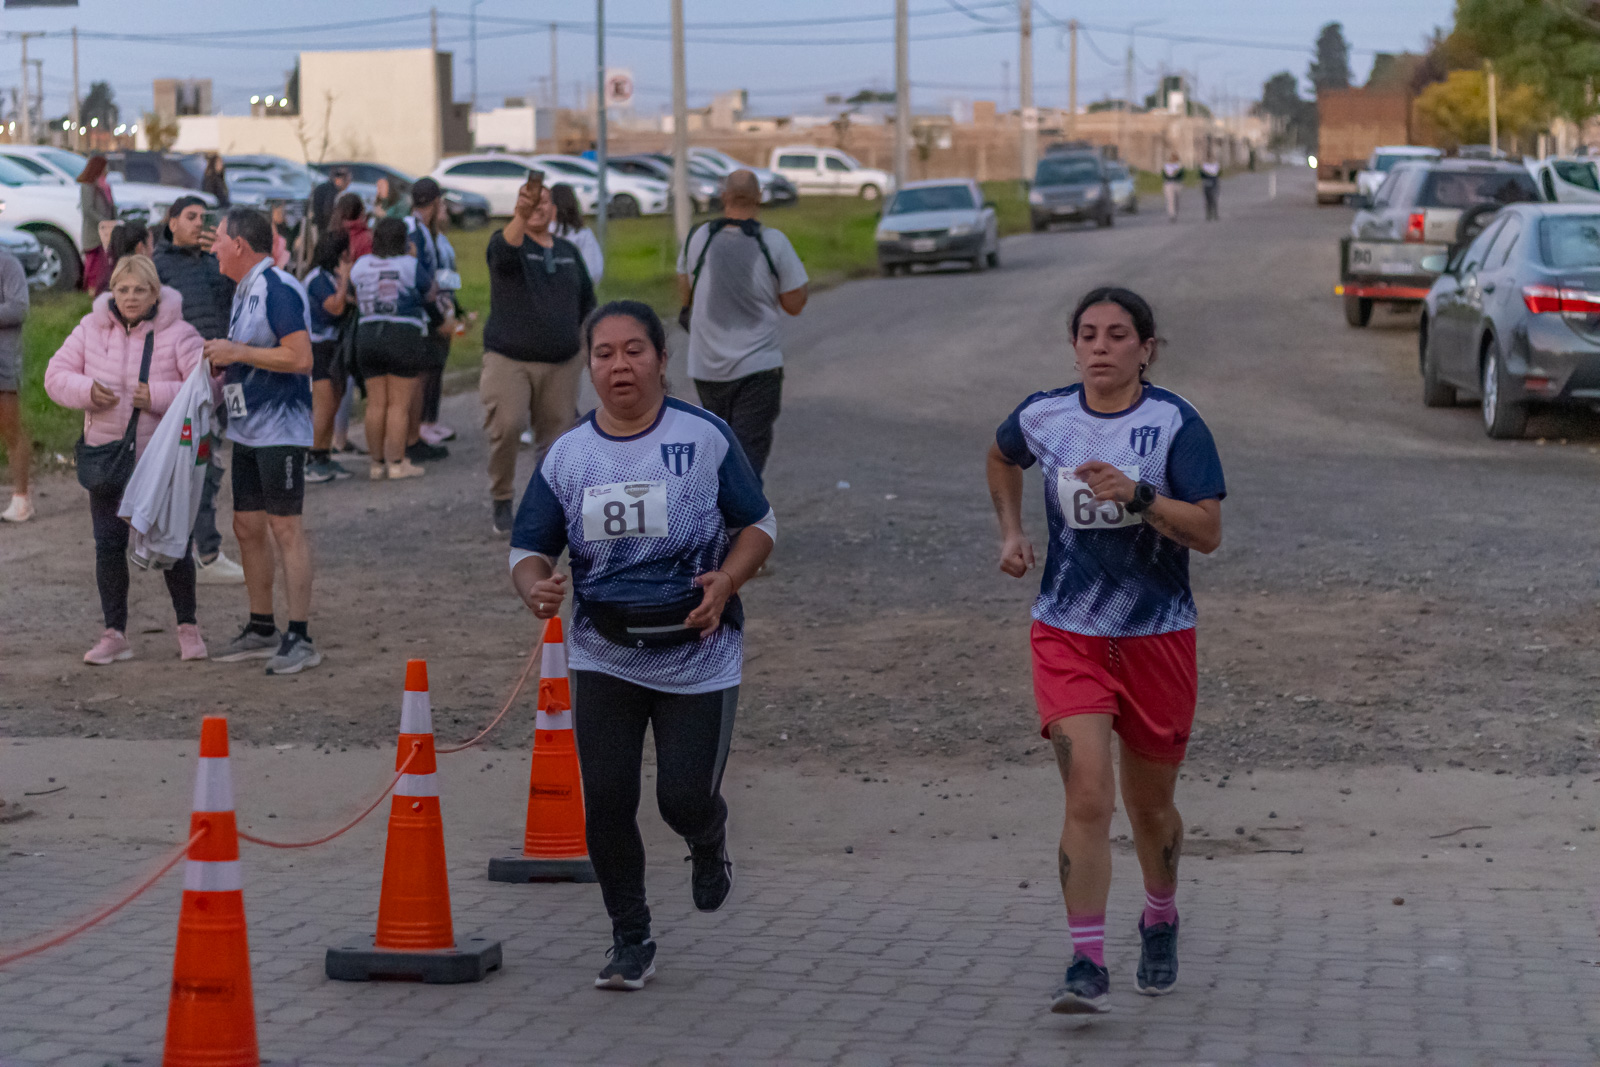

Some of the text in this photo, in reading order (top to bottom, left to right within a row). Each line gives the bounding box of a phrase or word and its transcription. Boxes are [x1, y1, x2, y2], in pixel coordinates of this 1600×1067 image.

[1135, 428, 1156, 436] SFC
[667, 445, 690, 454] SFC
[603, 499, 646, 536] 81
